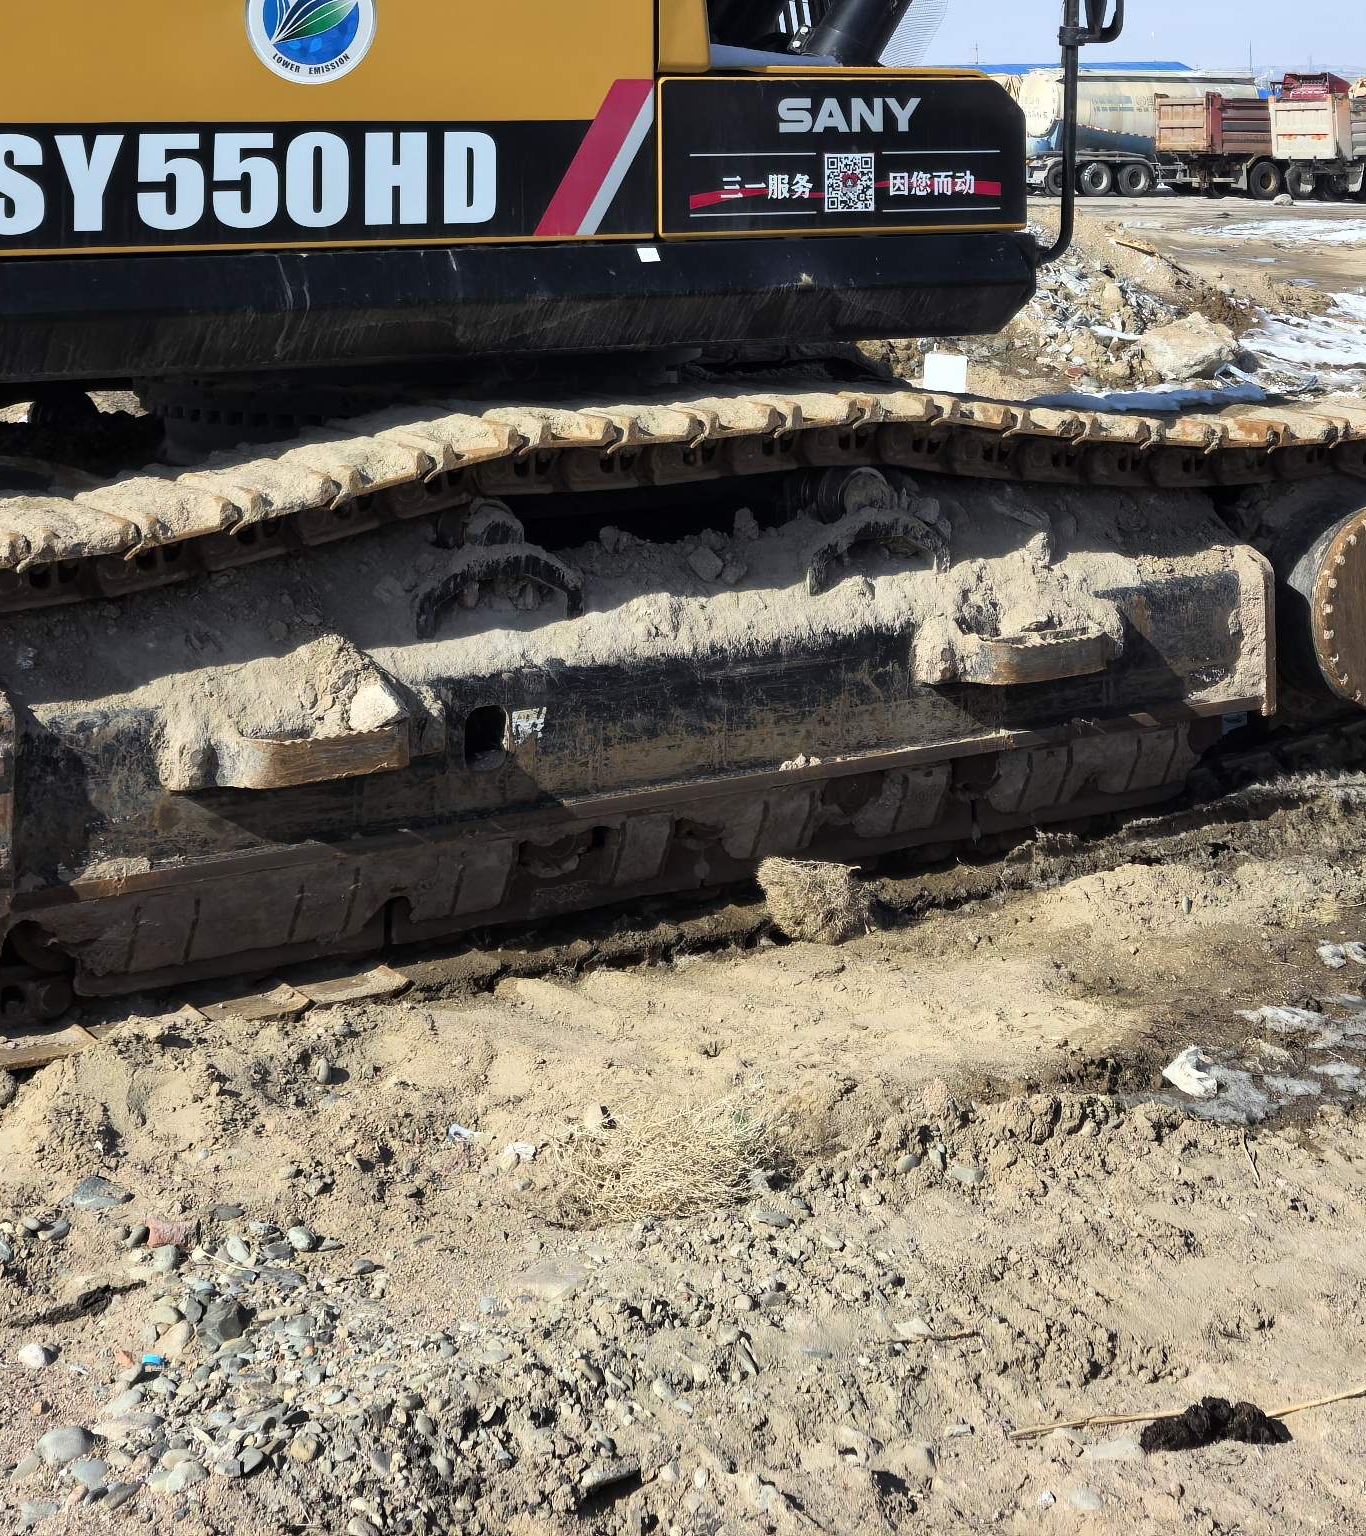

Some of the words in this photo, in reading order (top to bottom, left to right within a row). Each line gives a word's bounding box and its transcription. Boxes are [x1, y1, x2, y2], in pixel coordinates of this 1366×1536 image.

[272, 53, 301, 73] LOWER
[308, 53, 350, 75] EMISSION
[777, 97, 921, 133] SANY
[720, 173, 813, 200] 三一服务
[889, 171, 975, 197] 因您而动
